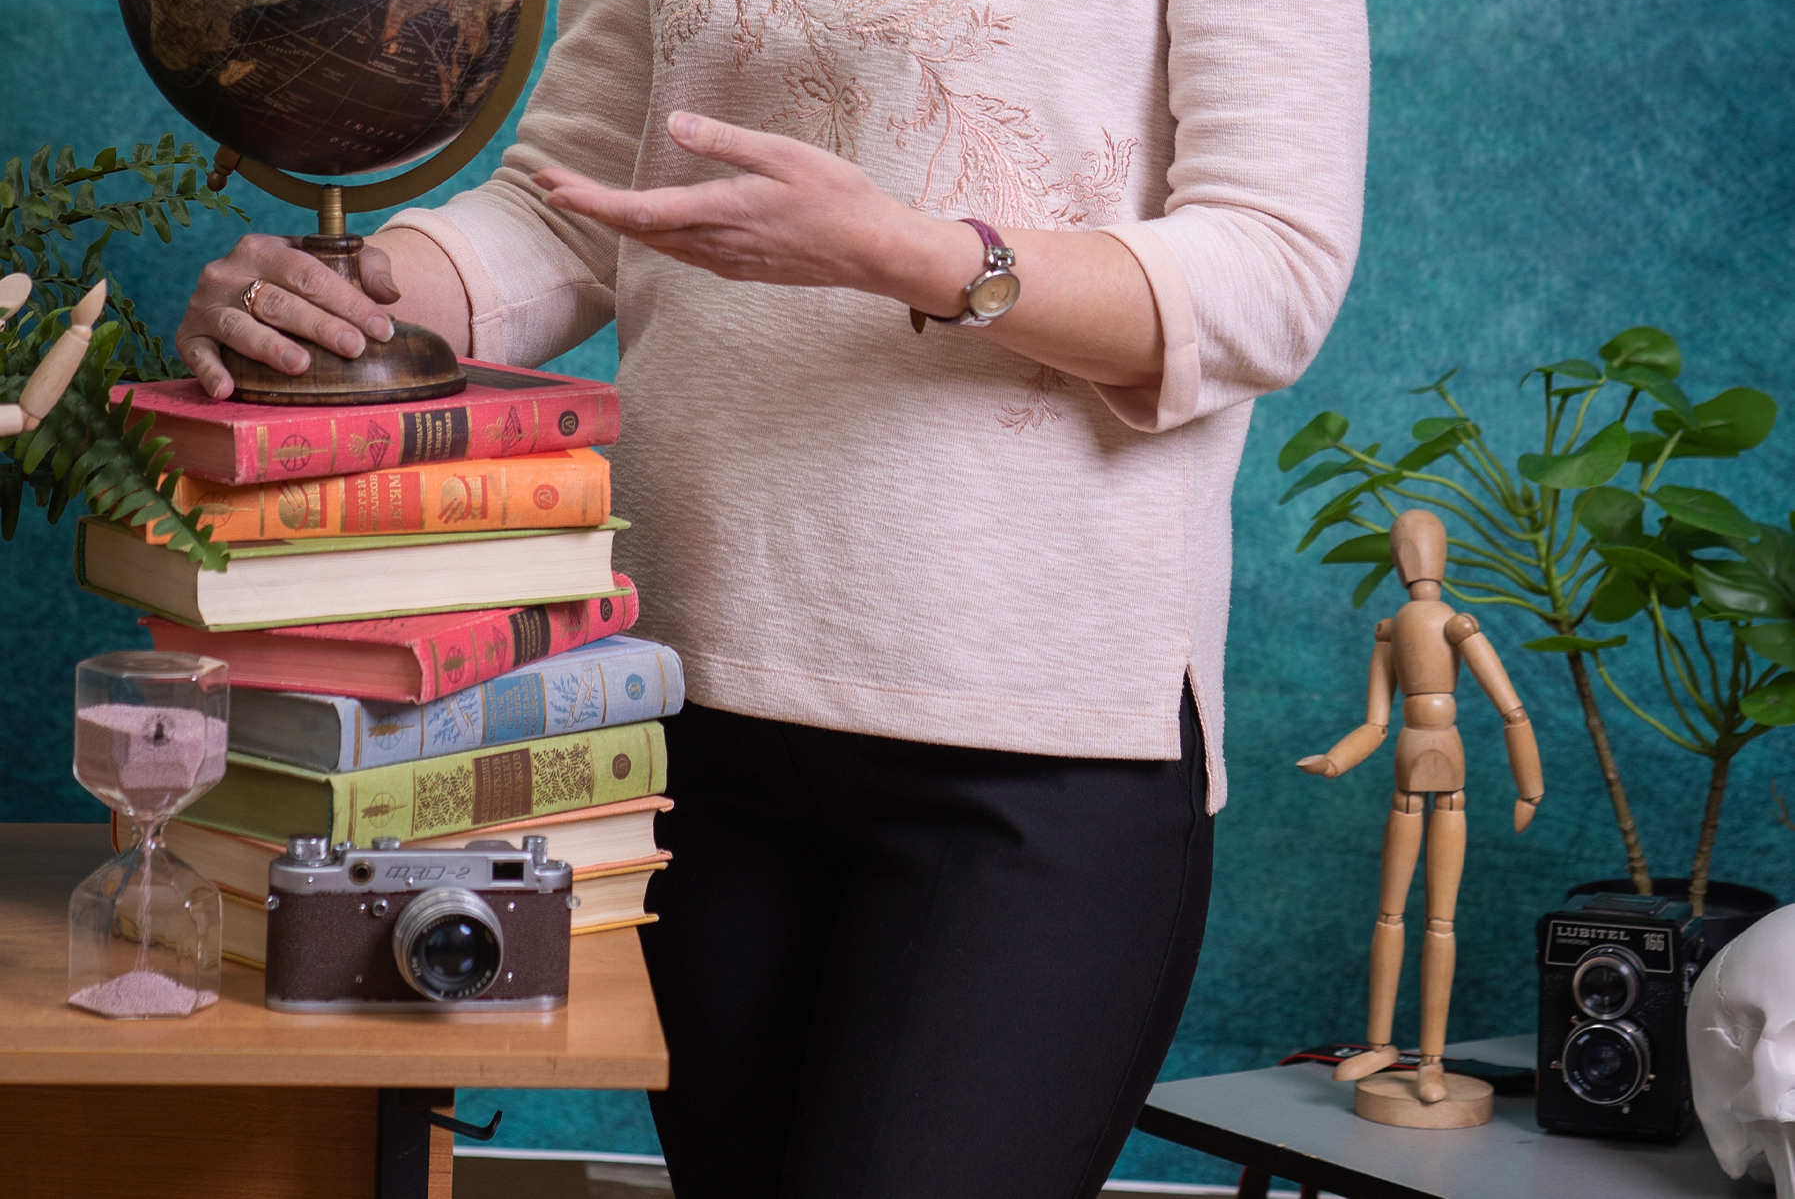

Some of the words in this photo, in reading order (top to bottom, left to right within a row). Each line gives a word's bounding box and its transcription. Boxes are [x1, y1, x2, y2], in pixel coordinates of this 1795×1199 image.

[355, 479, 367, 531] СЕРГЕЙ
[370, 474, 379, 532] ХАЛКОВ
[388, 474, 404, 530] ДЕТЯМ
[1556, 926, 1630, 941] LUBITEL
[1642, 933, 1665, 951] 166
